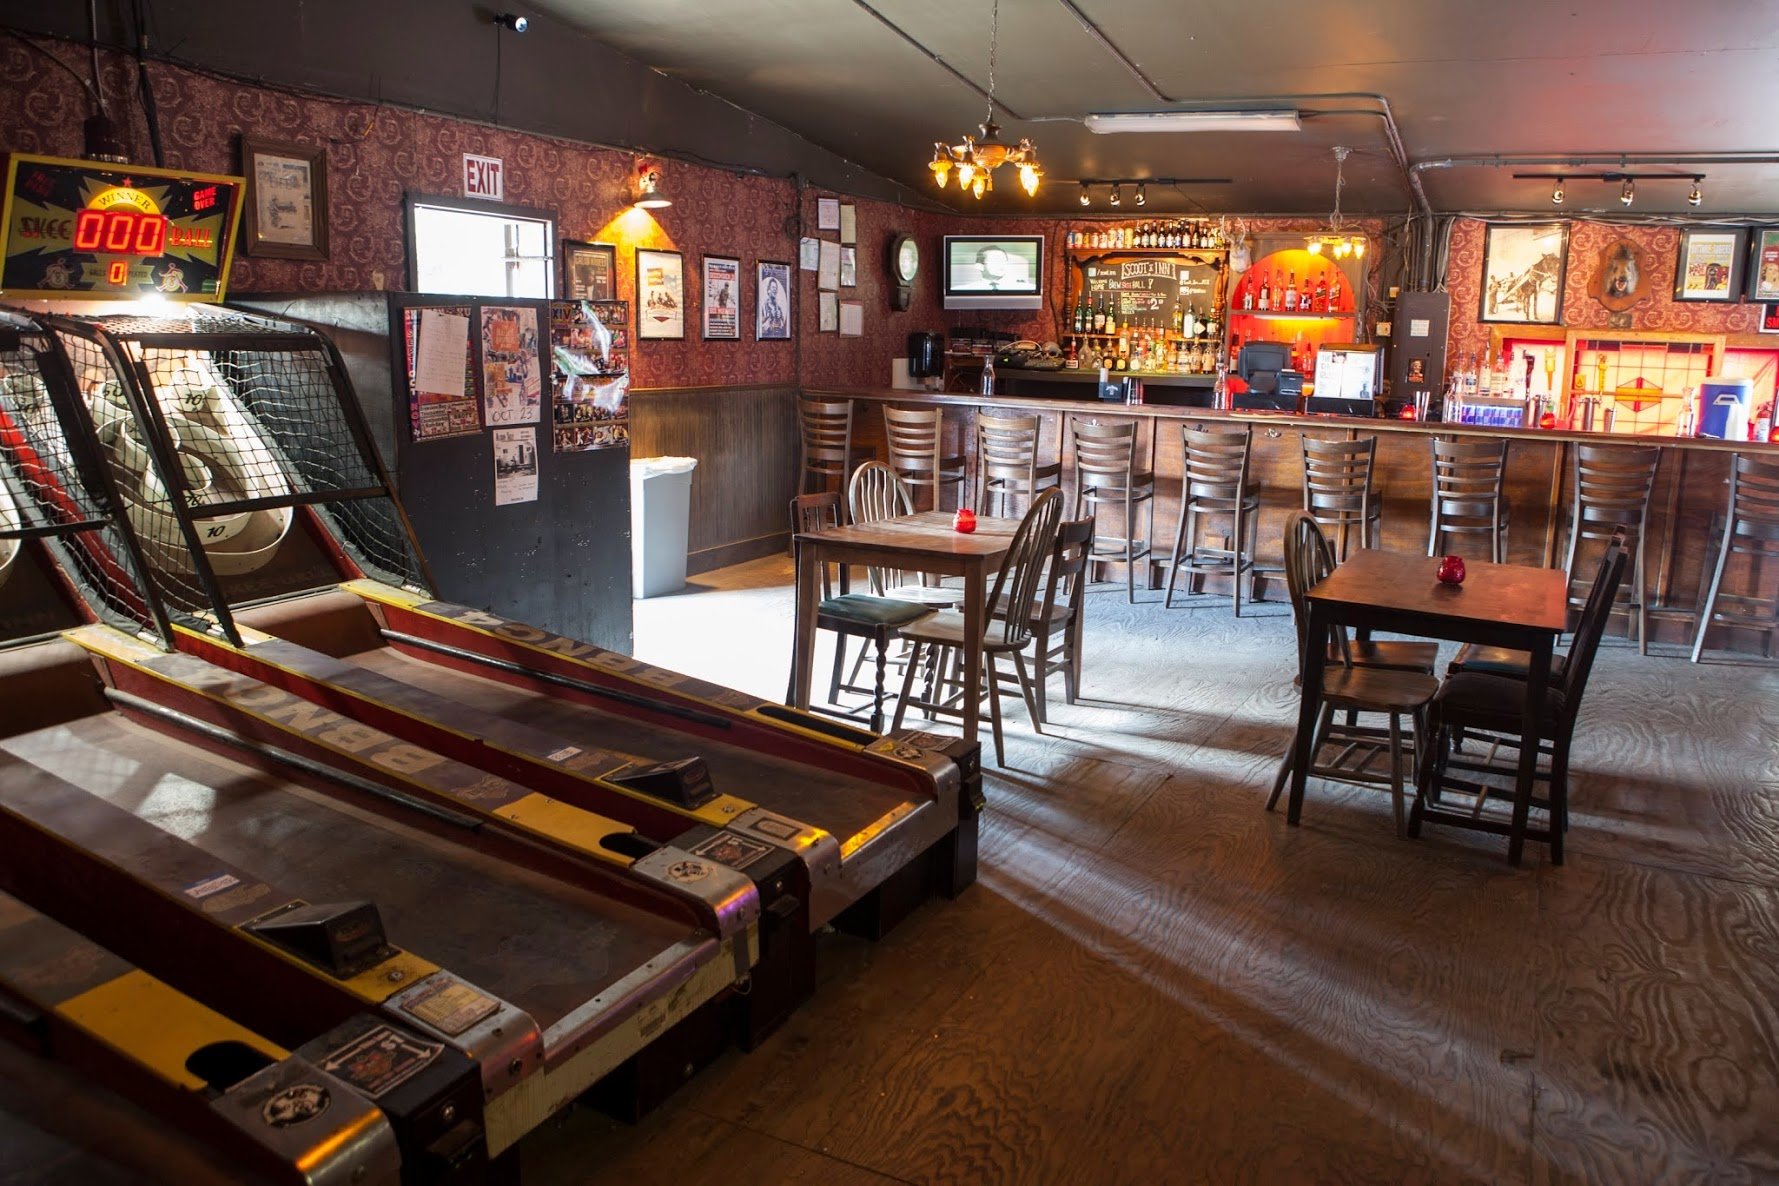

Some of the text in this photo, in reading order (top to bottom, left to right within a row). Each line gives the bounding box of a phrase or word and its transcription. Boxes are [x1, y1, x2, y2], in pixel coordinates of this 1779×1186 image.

[466, 158, 498, 196] EXIT
[99, 192, 151, 210] WINNER
[194, 187, 217, 201] GAME
[195, 198, 216, 211] OVER
[20, 216, 212, 247] SKEE BALL
[77, 213, 162, 249] 000
[110, 263, 125, 284] 0
[1125, 261, 1149, 276] SCOOT
[492, 410, 514, 423] OCT
[520, 407, 534, 420] 23
[207, 525, 227, 538] 10
